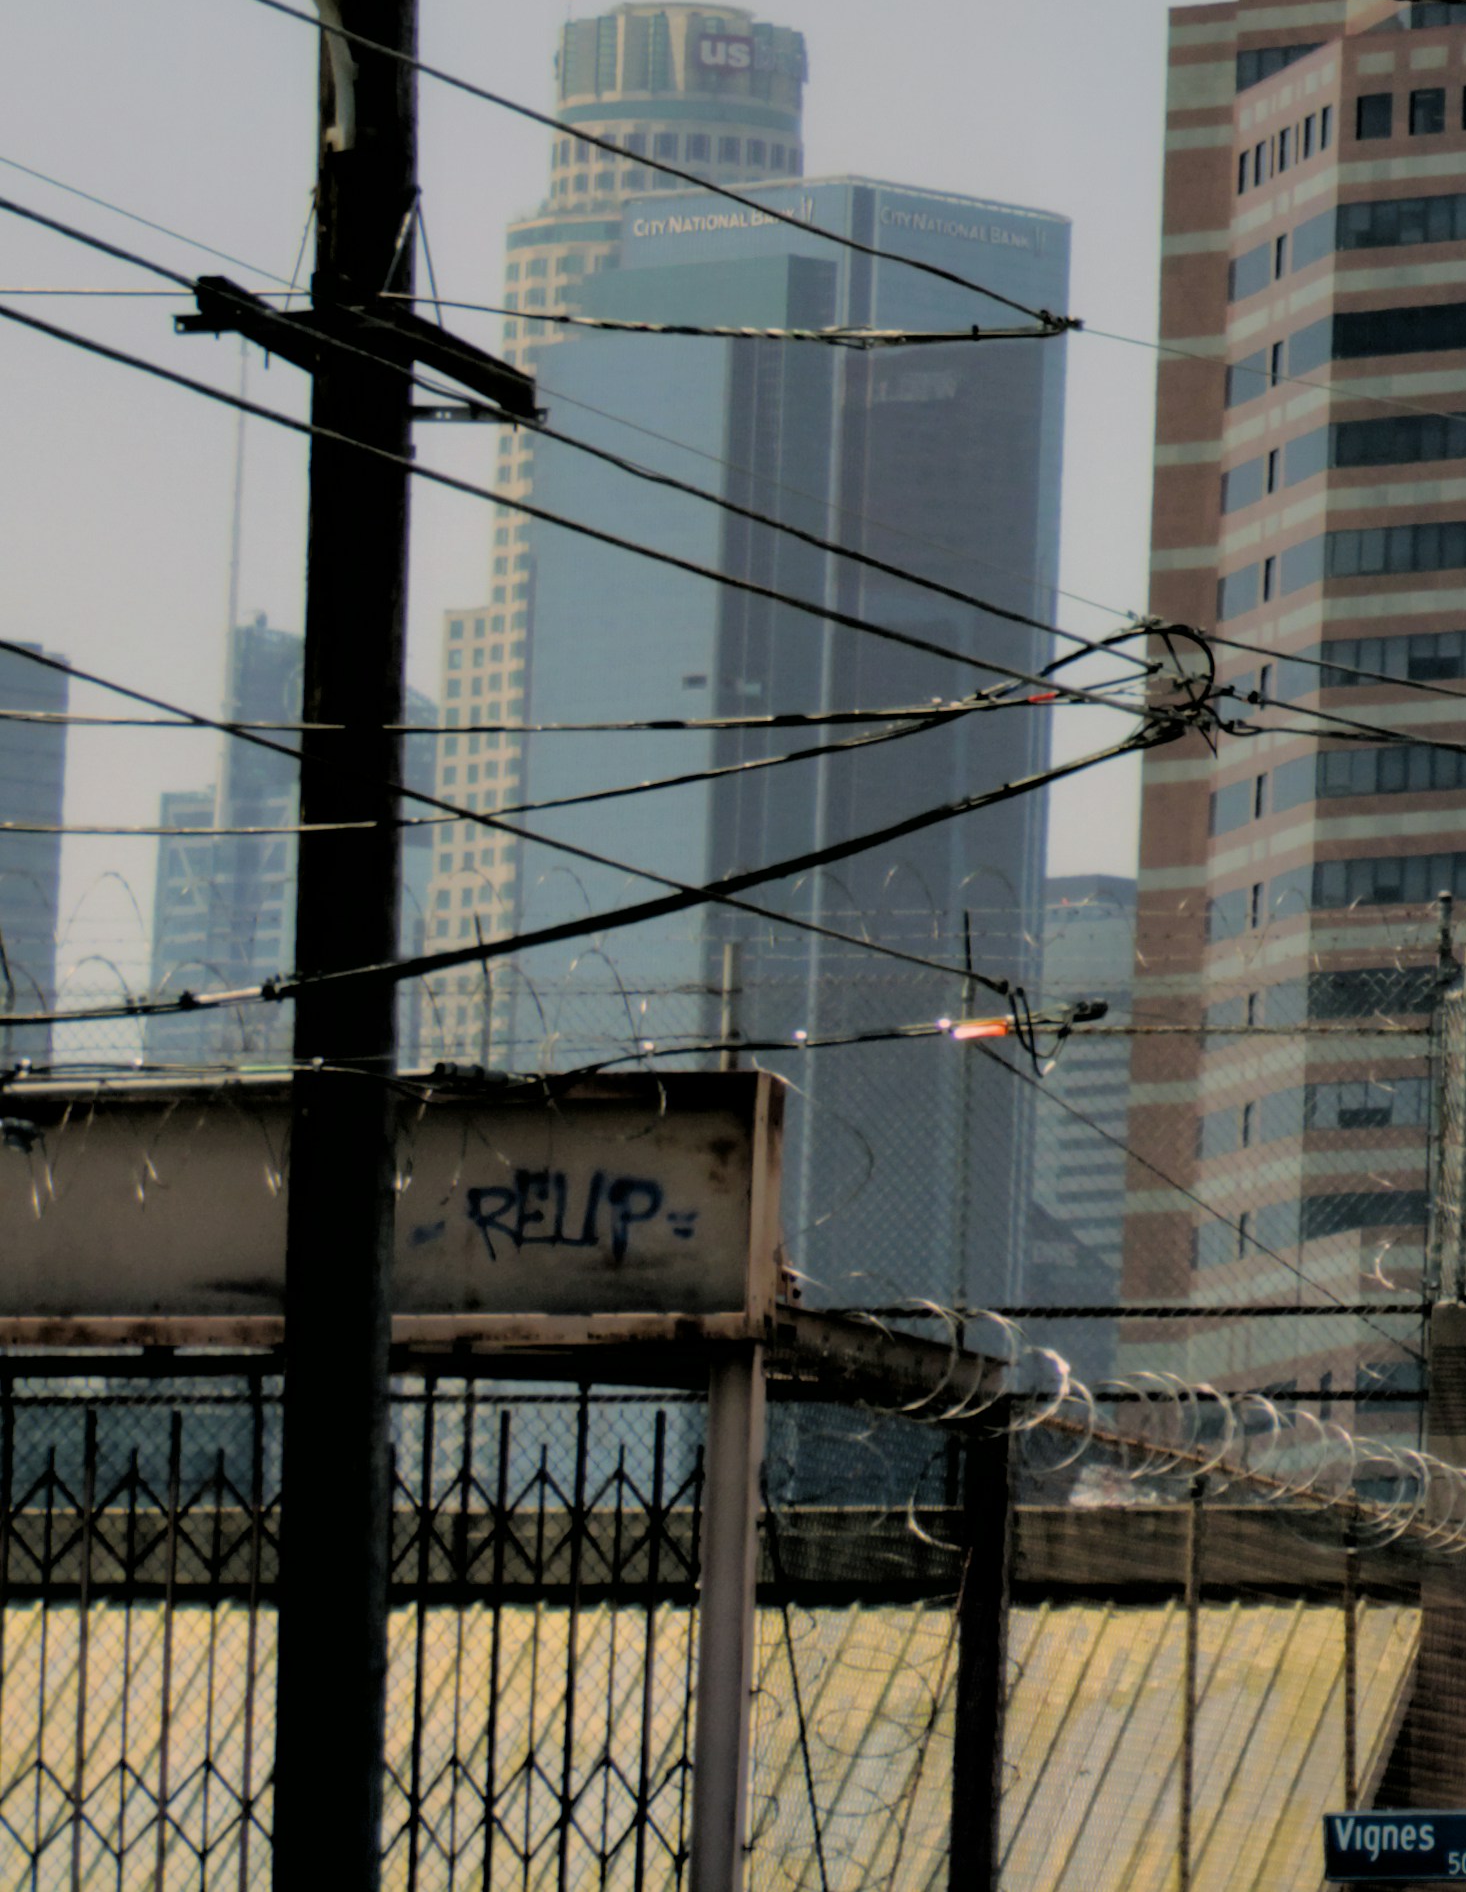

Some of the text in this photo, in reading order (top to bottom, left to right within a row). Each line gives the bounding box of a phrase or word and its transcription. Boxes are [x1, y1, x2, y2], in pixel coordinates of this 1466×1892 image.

[667, 211, 749, 235] NATIONAL
[912, 212, 988, 242] NATIONAL
[1334, 1817, 1435, 1862] Vignes
